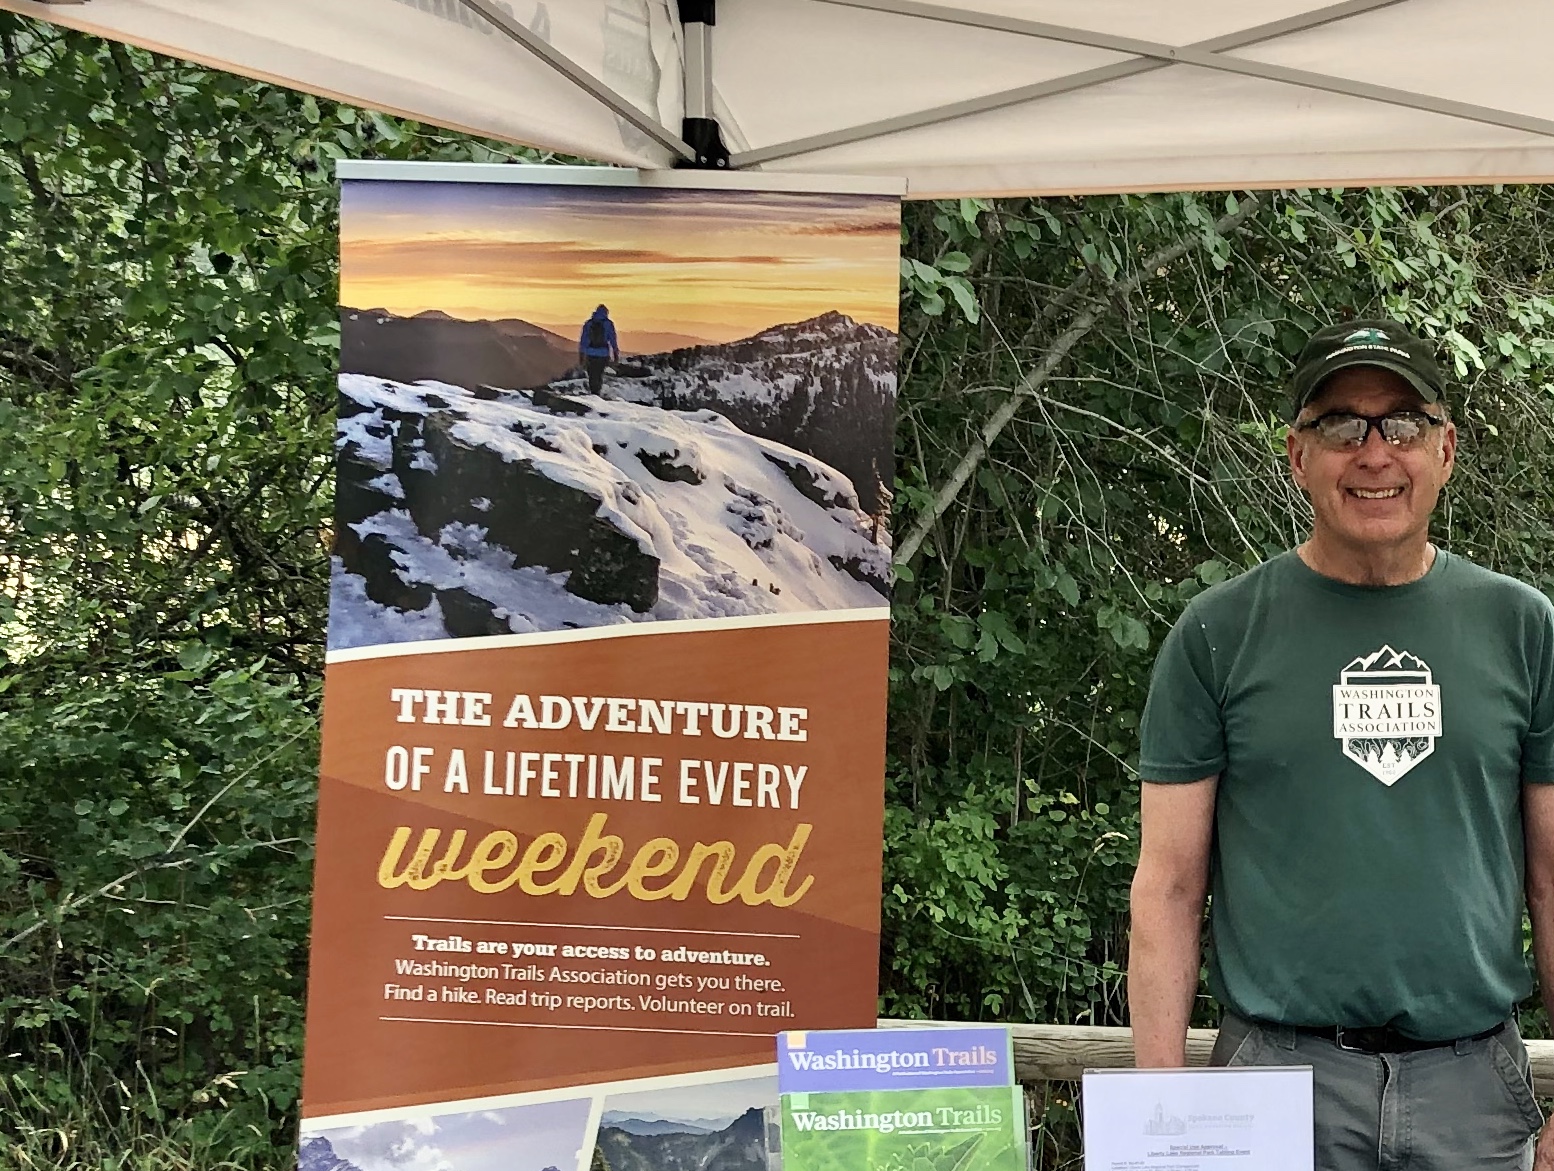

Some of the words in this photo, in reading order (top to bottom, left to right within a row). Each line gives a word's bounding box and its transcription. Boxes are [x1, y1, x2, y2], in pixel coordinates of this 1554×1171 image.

[1340, 689, 1434, 699] WASHINGTON
[391, 688, 492, 726] THE
[503, 694, 808, 742] ADVENTURE
[1339, 702, 1435, 719] TRAILS
[1339, 721, 1436, 732] ASSOCIATION
[385, 745, 435, 790] OF
[444, 749, 469, 794] A
[484, 750, 663, 802] LIFETIME
[680, 759, 808, 809] EVERY
[377, 812, 815, 907] weekend
[412, 934, 472, 953] Trails
[476, 941, 508, 955] are
[512, 942, 557, 959] your
[561, 944, 630, 960] access
[634, 946, 656, 961] to
[661, 946, 771, 966] adventure.
[394, 958, 499, 982] Washington
[501, 963, 545, 982] Trails
[548, 966, 651, 987] Association
[655, 972, 693, 991] gets
[697, 976, 730, 992] you
[735, 974, 786, 992] there.
[384, 983, 423, 1001] Find
[427, 989, 438, 1002] a
[441, 985, 481, 1004] hike.
[485, 988, 527, 1007] Read
[530, 990, 562, 1011] trip
[566, 993, 636, 1012] reports.
[638, 994, 725, 1015] Volunteer
[728, 1003, 752, 1016] on
[756, 1000, 796, 1018] trail.
[788, 1049, 929, 1072] Washington
[932, 1046, 997, 1067] Trails
[791, 1109, 934, 1133] Washington
[936, 1105, 1002, 1126] Trails
